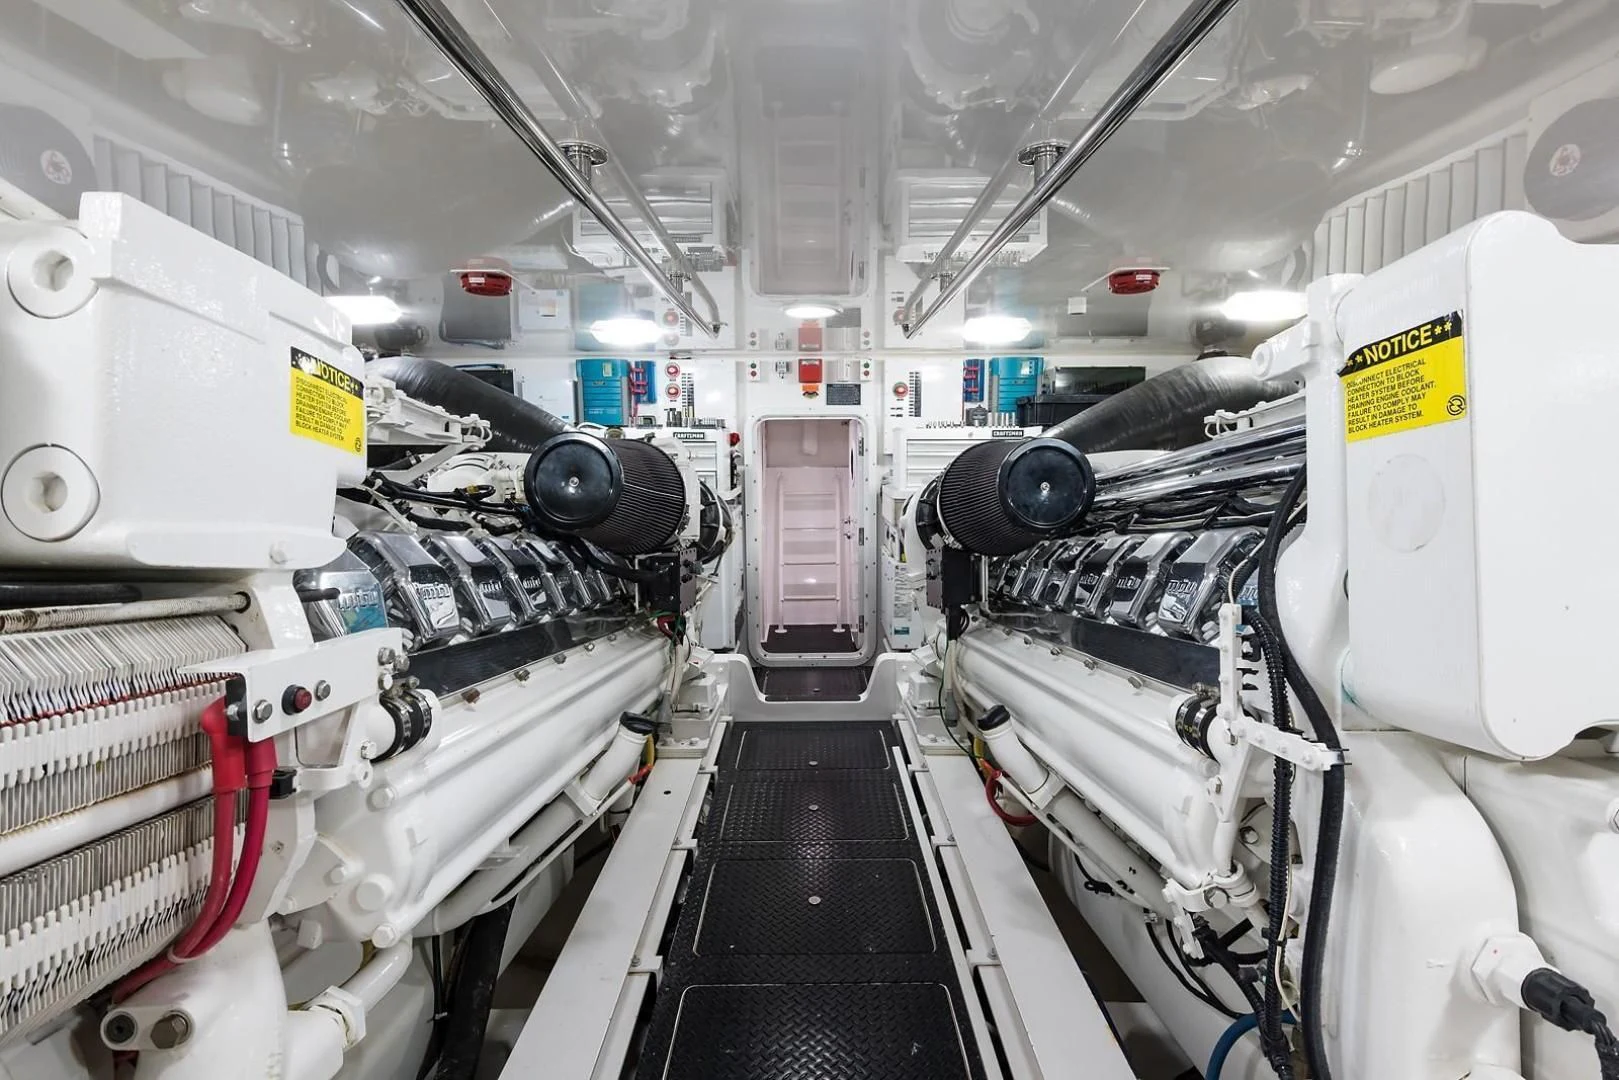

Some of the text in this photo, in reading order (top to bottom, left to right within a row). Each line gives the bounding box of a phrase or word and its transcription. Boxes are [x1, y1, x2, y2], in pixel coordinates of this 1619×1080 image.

[1385, 359, 1426, 378] ELECTRICAL
[1347, 381, 1384, 396] CONNECTION
[1397, 369, 1419, 381] BLOCK
[1348, 376, 1424, 403] HEATER SYSTEM BEFORE
[1348, 399, 1375, 411] DRAINING
[1376, 393, 1399, 404] ENGINE
[1348, 393, 1426, 418] FAILURE TO COMPLY MAY
[1348, 416, 1370, 426] RESULT
[1379, 407, 1406, 418] DAMAGE
[1348, 424, 1367, 433] BLOCK
[1369, 418, 1393, 429] HEATER
